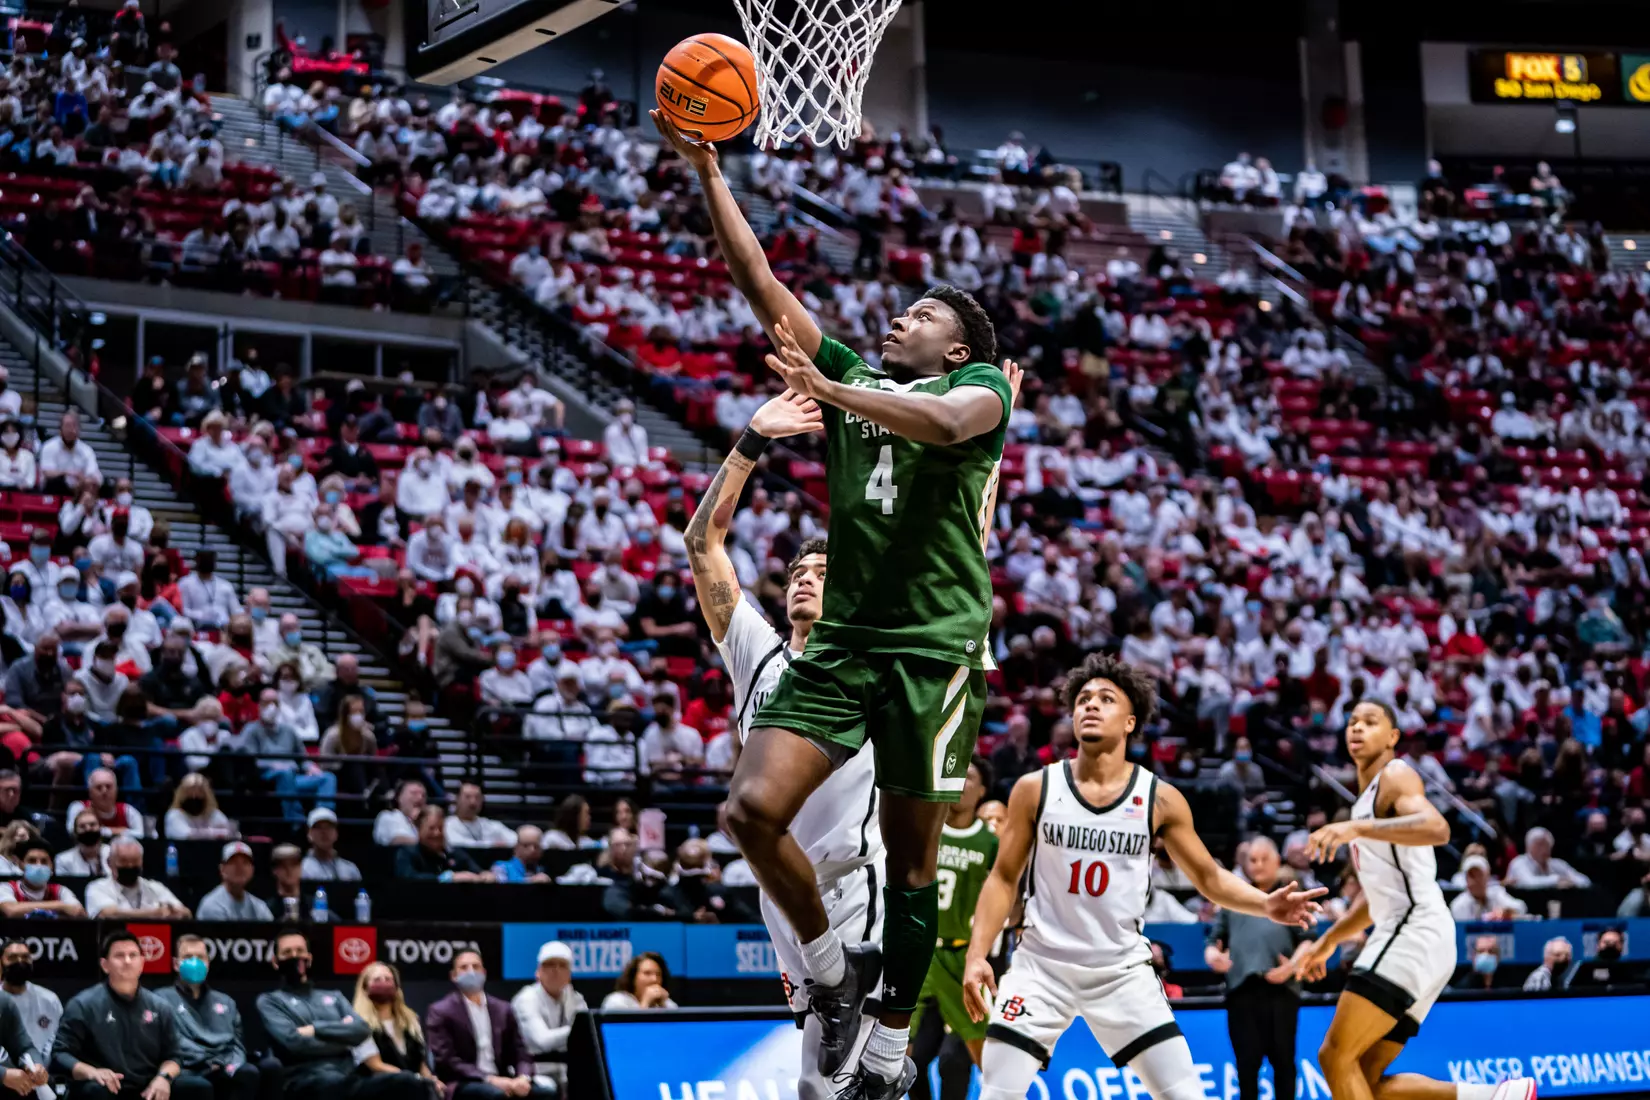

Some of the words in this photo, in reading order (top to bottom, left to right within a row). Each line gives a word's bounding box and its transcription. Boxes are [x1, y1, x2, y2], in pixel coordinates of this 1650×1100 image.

[1510, 54, 1559, 81] FOX
[1563, 55, 1581, 82] 5
[660, 80, 707, 117] ELITE
[861, 421, 895, 439] STA
[865, 444, 898, 515] 4
[1043, 822, 1065, 847] SAN
[1067, 825, 1107, 852] DIEGO
[1108, 830, 1147, 855] STATE
[1067, 858, 1110, 897] 10
[0, 936, 79, 961] OTA
[201, 937, 275, 961] OYOT
[564, 940, 633, 973] ELTZER
